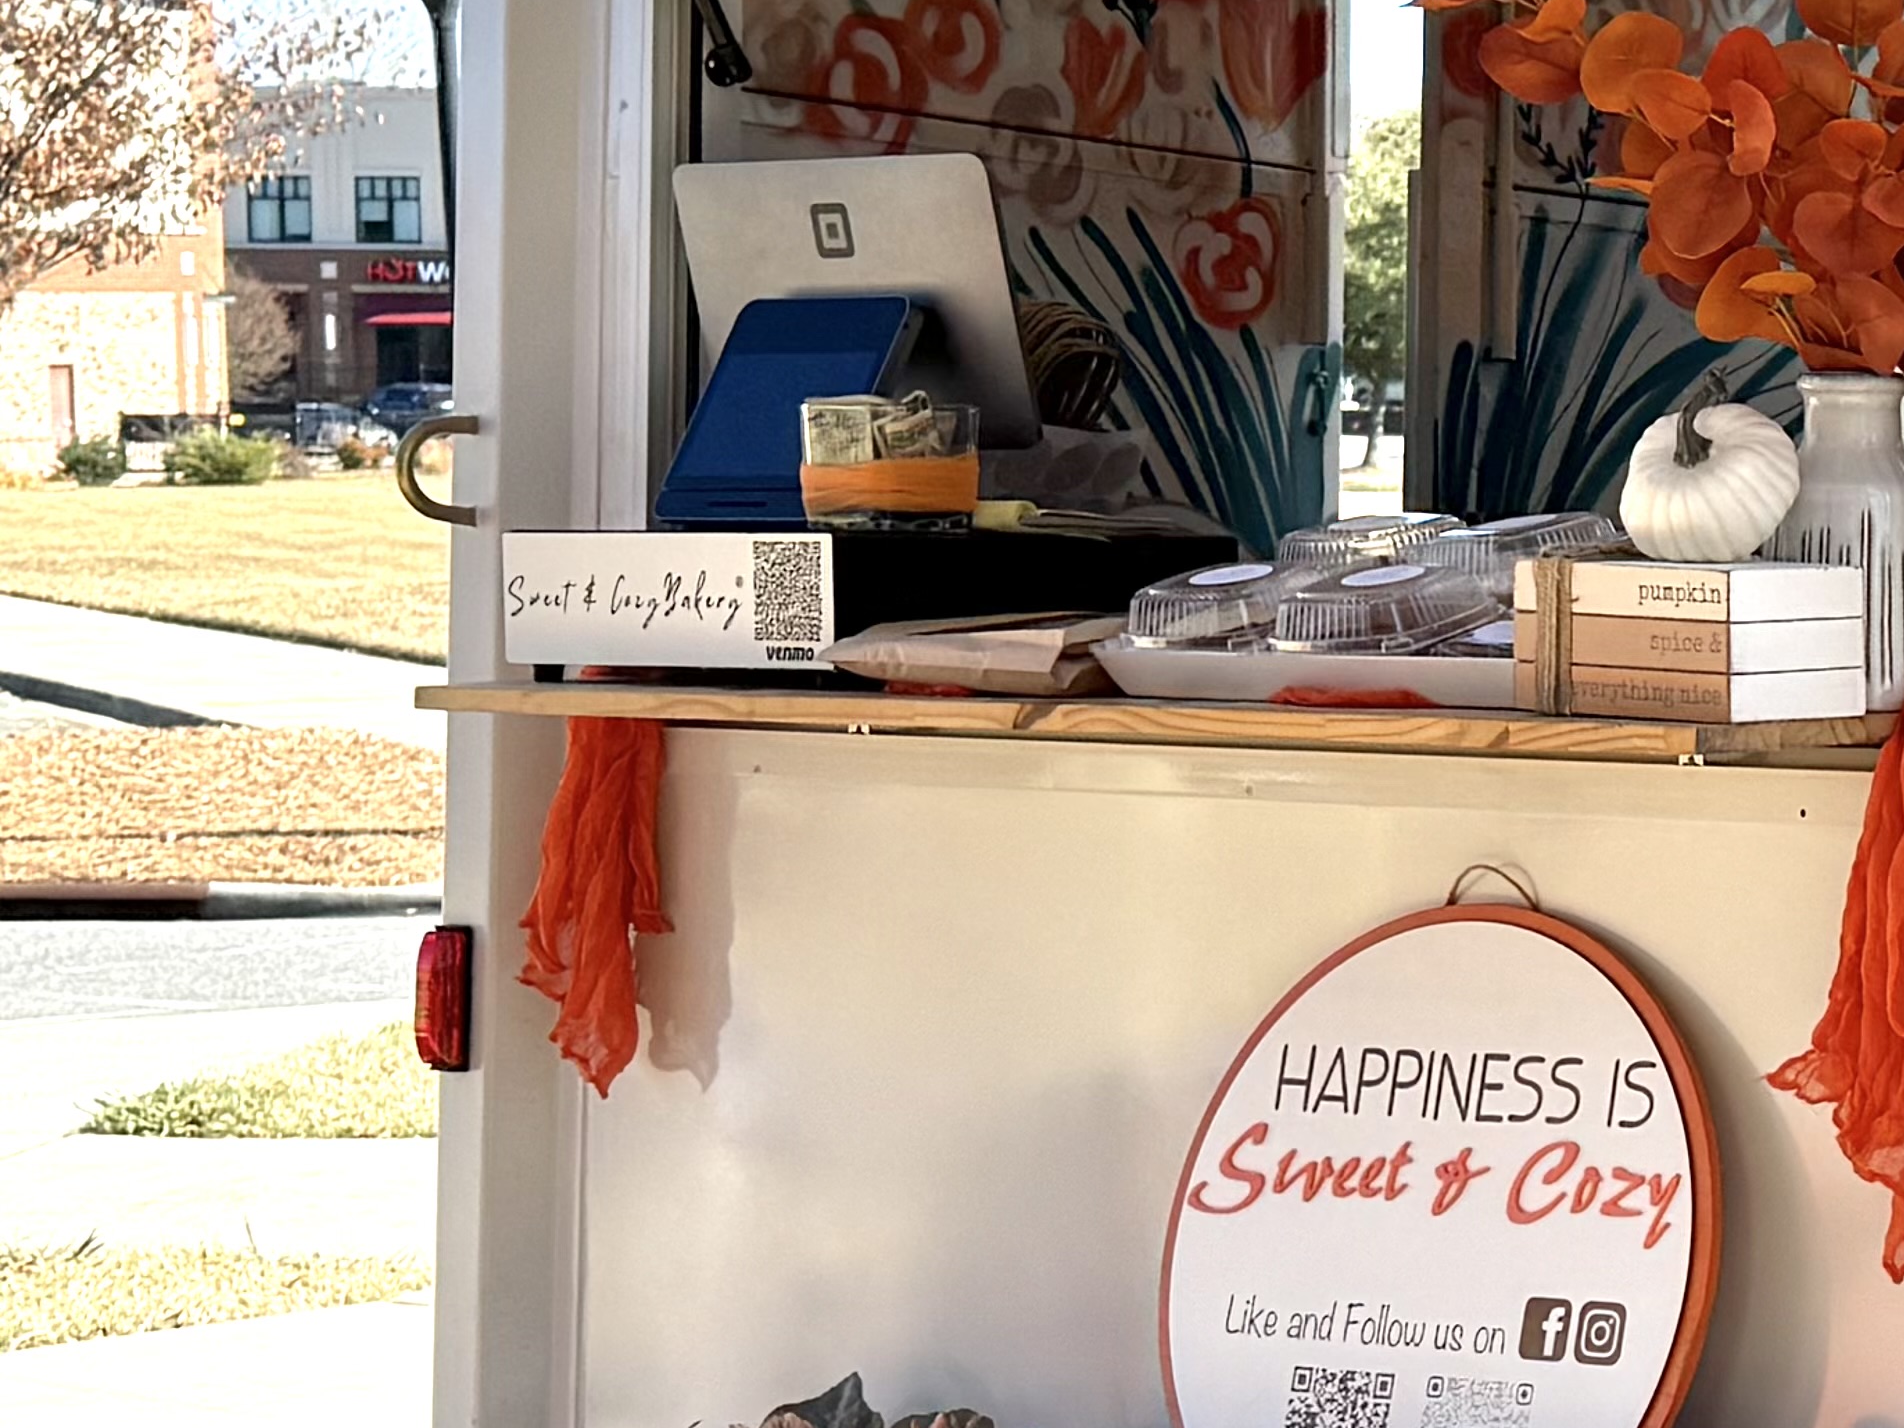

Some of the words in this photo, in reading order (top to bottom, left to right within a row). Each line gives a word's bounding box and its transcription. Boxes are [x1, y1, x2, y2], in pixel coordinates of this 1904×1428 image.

[508, 575, 576, 616] Sweet
[583, 574, 597, 612] &
[610, 574, 660, 629] Cozy
[1638, 581, 1721, 607] pumpkin
[766, 645, 814, 662] venmo
[1650, 631, 1703, 655] spice
[1709, 631, 1722, 653] &
[1680, 684, 1722, 706] nice
[1274, 1044, 1584, 1125] HAPPINESS
[1606, 1058, 1656, 1128] IS
[1187, 1121, 1413, 1215] Sweet
[1431, 1146, 1491, 1216] &
[1505, 1140, 1681, 1250] Cozy
[1225, 1294, 1278, 1339] Like
[1288, 1301, 1338, 1343] and
[1343, 1302, 1426, 1348] Follow
[1434, 1321, 1465, 1352] us
[1474, 1325, 1505, 1355] on
